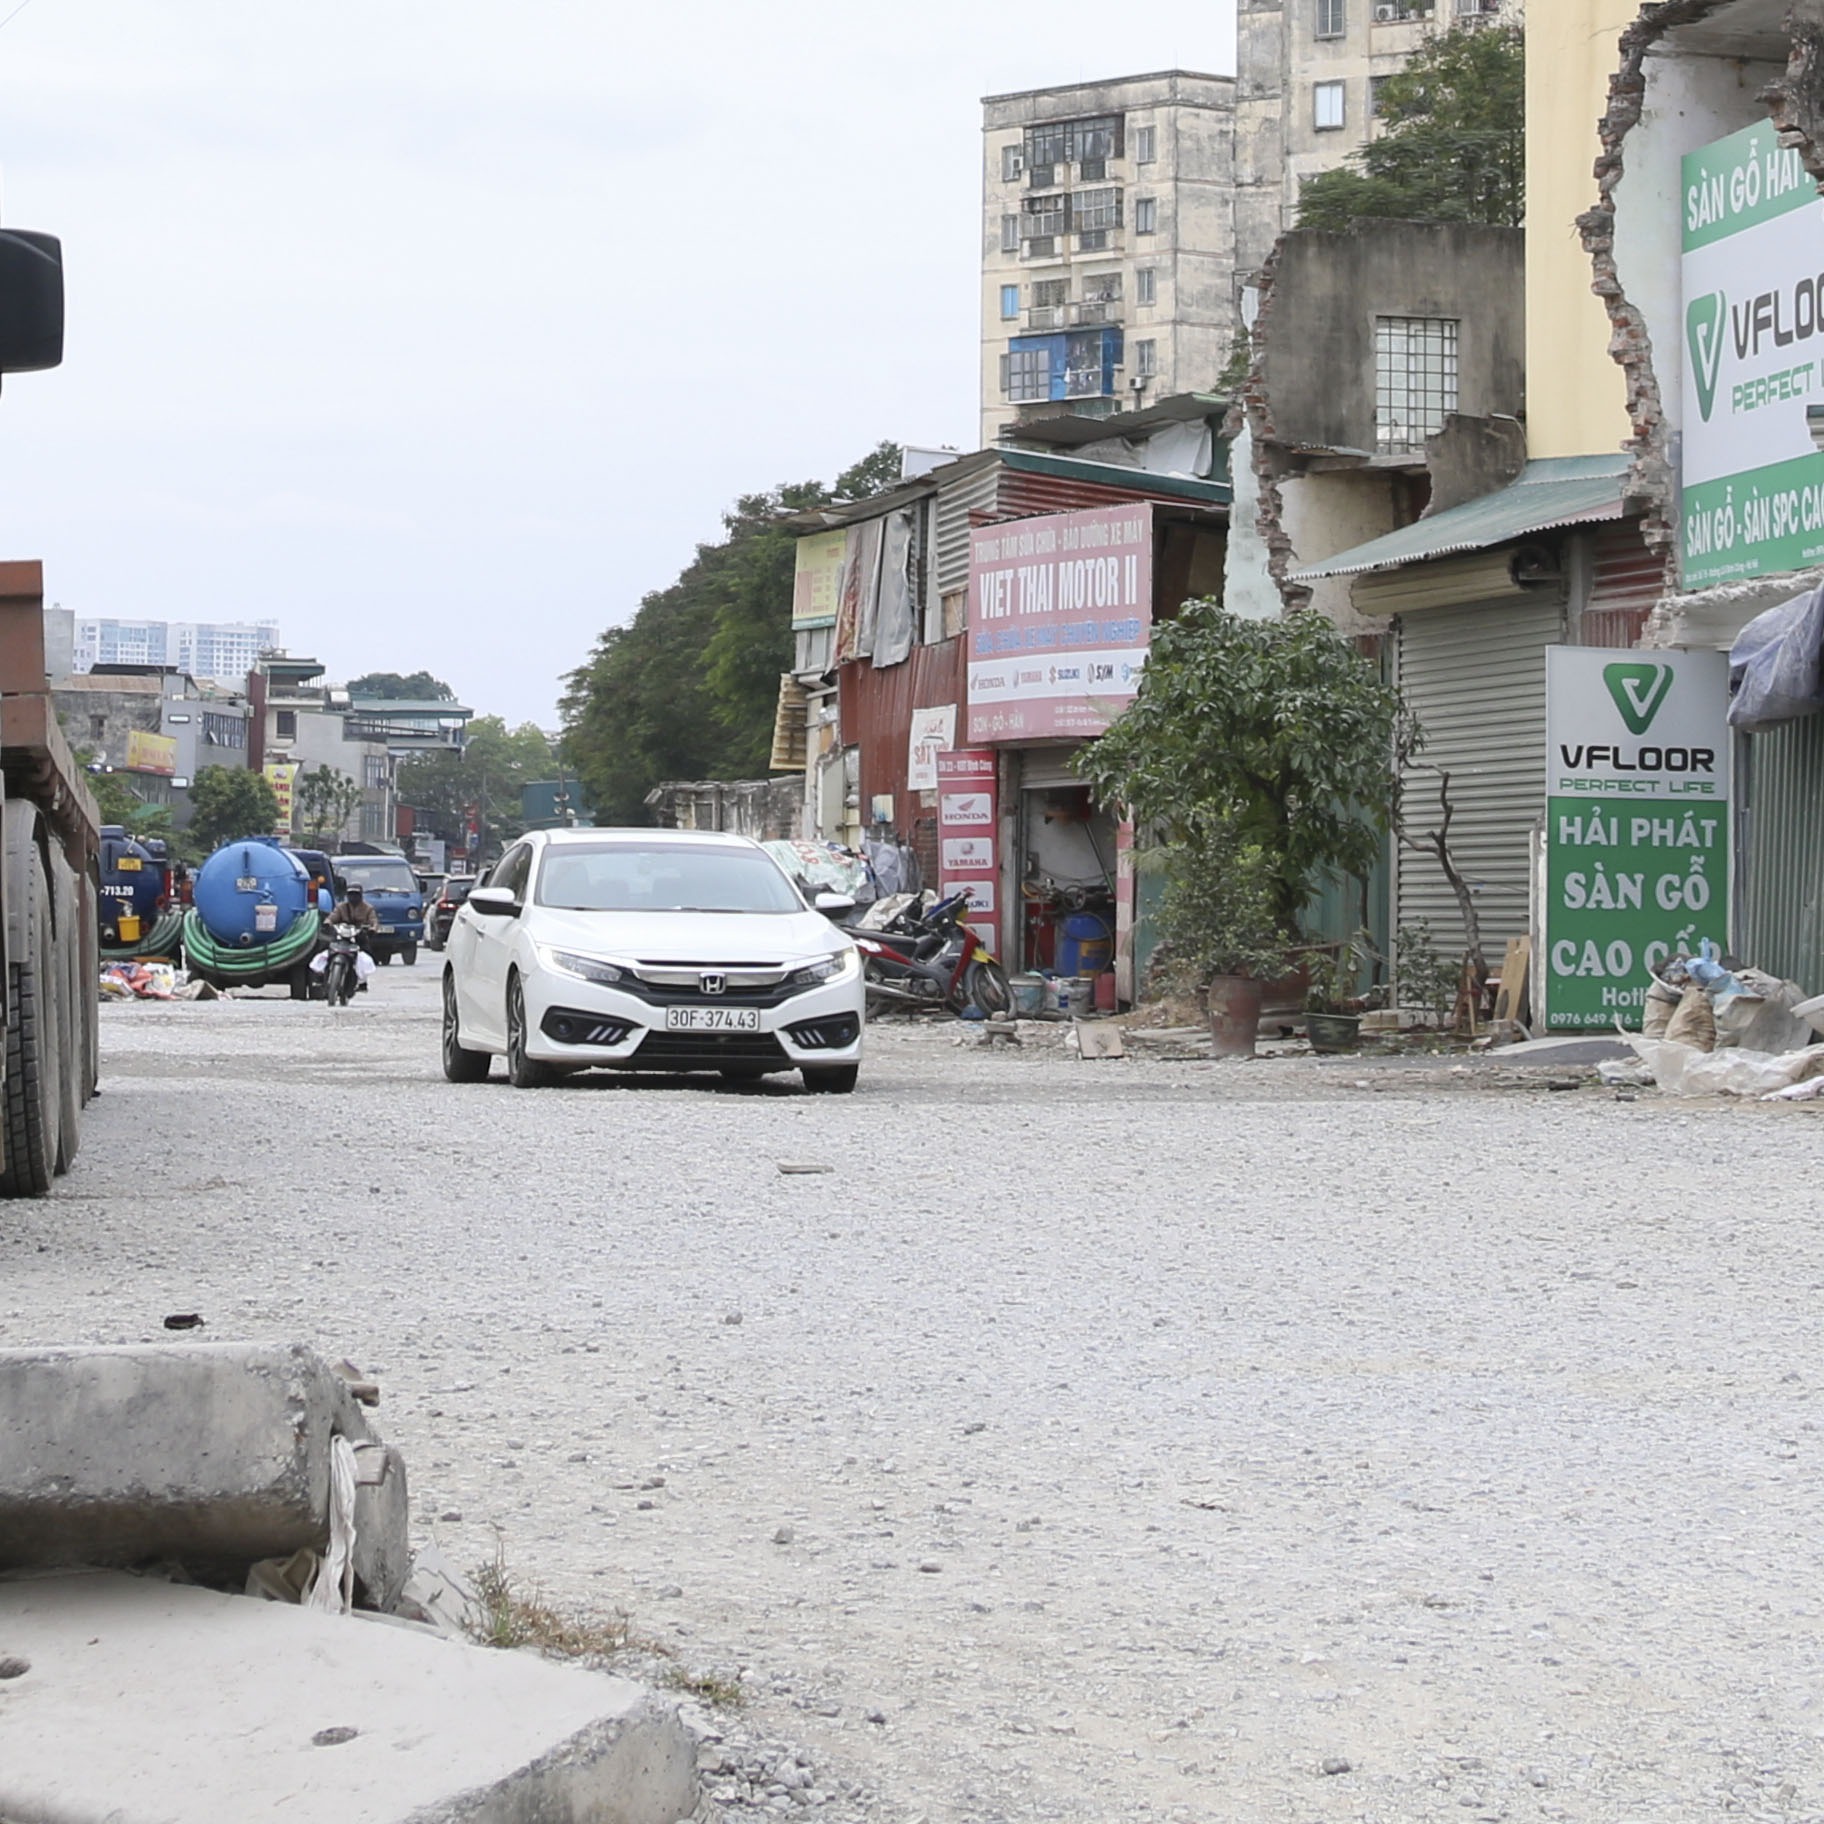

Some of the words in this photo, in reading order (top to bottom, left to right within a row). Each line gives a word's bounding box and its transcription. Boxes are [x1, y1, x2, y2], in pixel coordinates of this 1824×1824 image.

[1687, 168, 1724, 232] SÀN
[1730, 138, 1760, 213] GỖ
[1732, 362, 1814, 414] PERFECT
[1687, 501, 1711, 557] SÀN
[1714, 485, 1734, 551] GỖ
[1744, 486, 1770, 544] SÀN
[1773, 489, 1799, 539] SPC
[980, 569, 1013, 619] VIET
[1018, 563, 1053, 614] THAI
[1058, 556, 1118, 610] MOTOR
[1560, 744, 1715, 773] VFLOOR
[1559, 778, 1660, 792] PERFECT
[1669, 781, 1715, 794] LIFE
[944, 812, 989, 821] HONDA
[1559, 806, 1618, 846] HẢI
[1631, 810, 1717, 848] PHÁT
[948, 858, 988, 866] YAMAHA
[1564, 861, 1644, 910] SÀN
[1655, 855, 1710, 911] GỖ
[1551, 939, 1633, 977] CAO
[1603, 986, 1648, 1006] Hotl
[670, 1009, 756, 1028] 30F-374.43
[1550, 1013, 1581, 1025] 0976
[1584, 1013, 1606, 1025] 649
